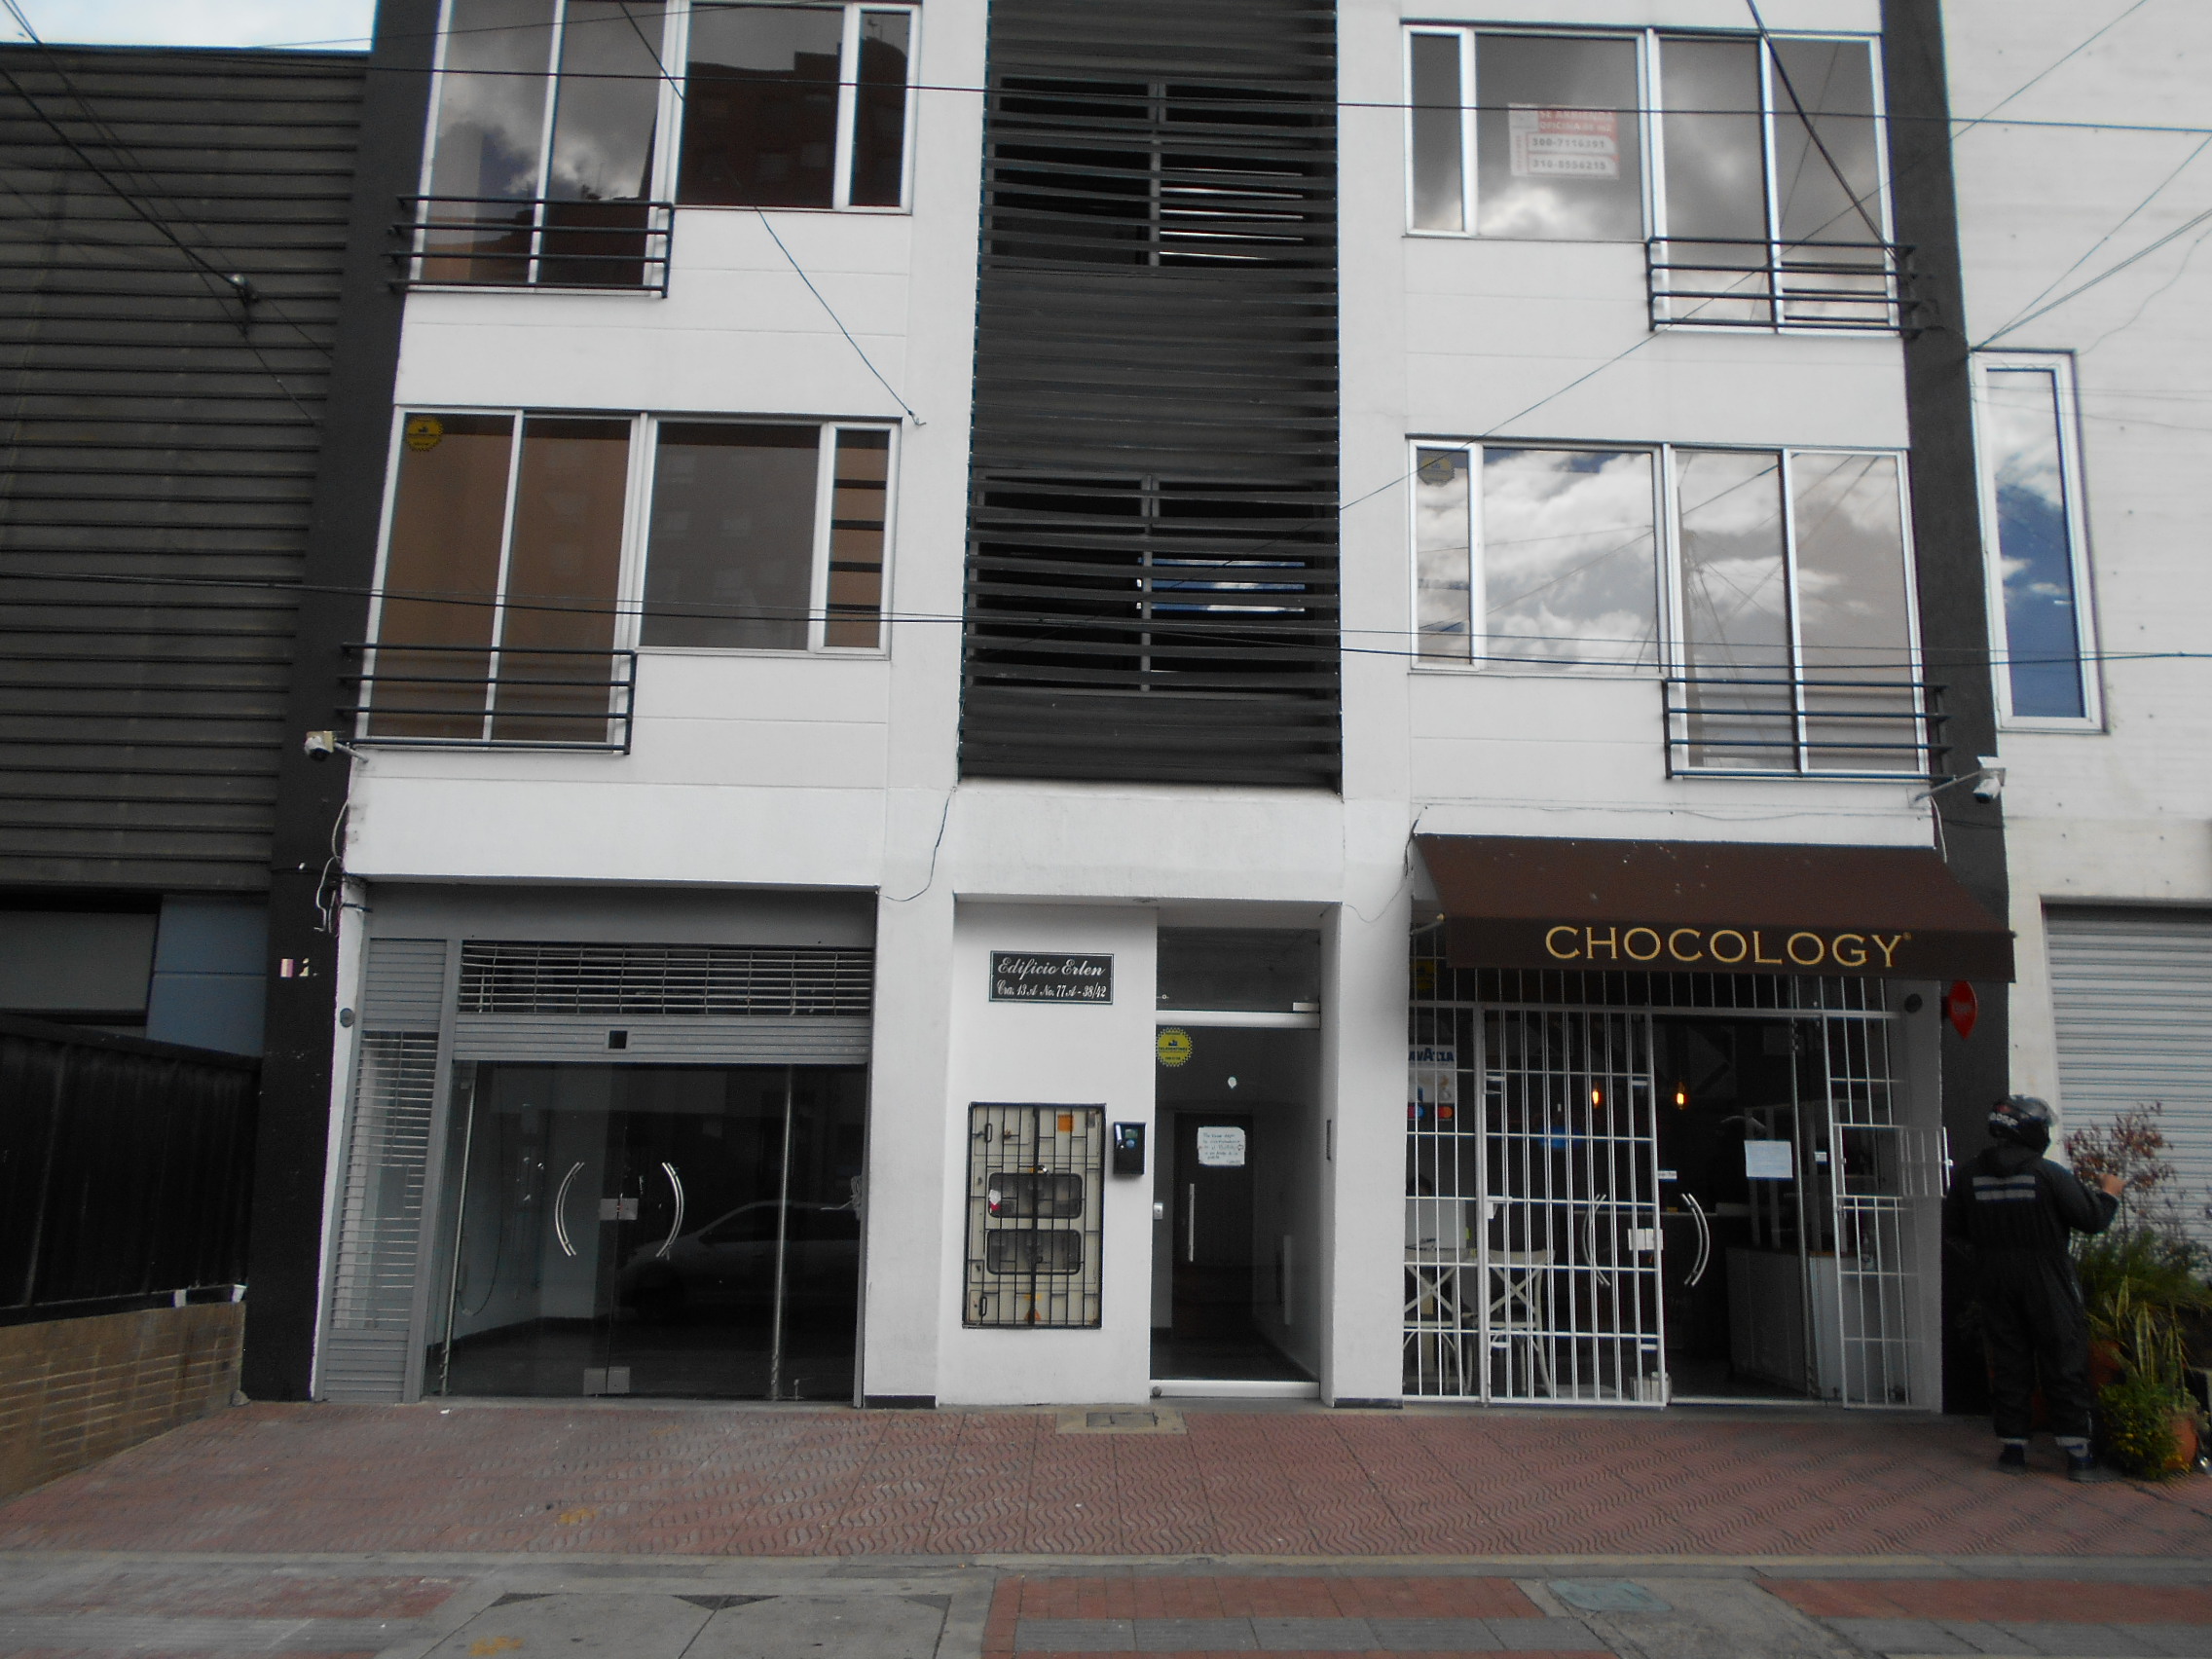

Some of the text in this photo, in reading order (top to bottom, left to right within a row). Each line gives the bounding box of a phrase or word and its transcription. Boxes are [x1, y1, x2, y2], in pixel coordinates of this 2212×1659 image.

[1545, 925, 1902, 968] CHOCOLOGY
[998, 957, 1106, 980] Edificio Erlen
[1408, 1048, 1455, 1062] AVAZZA
